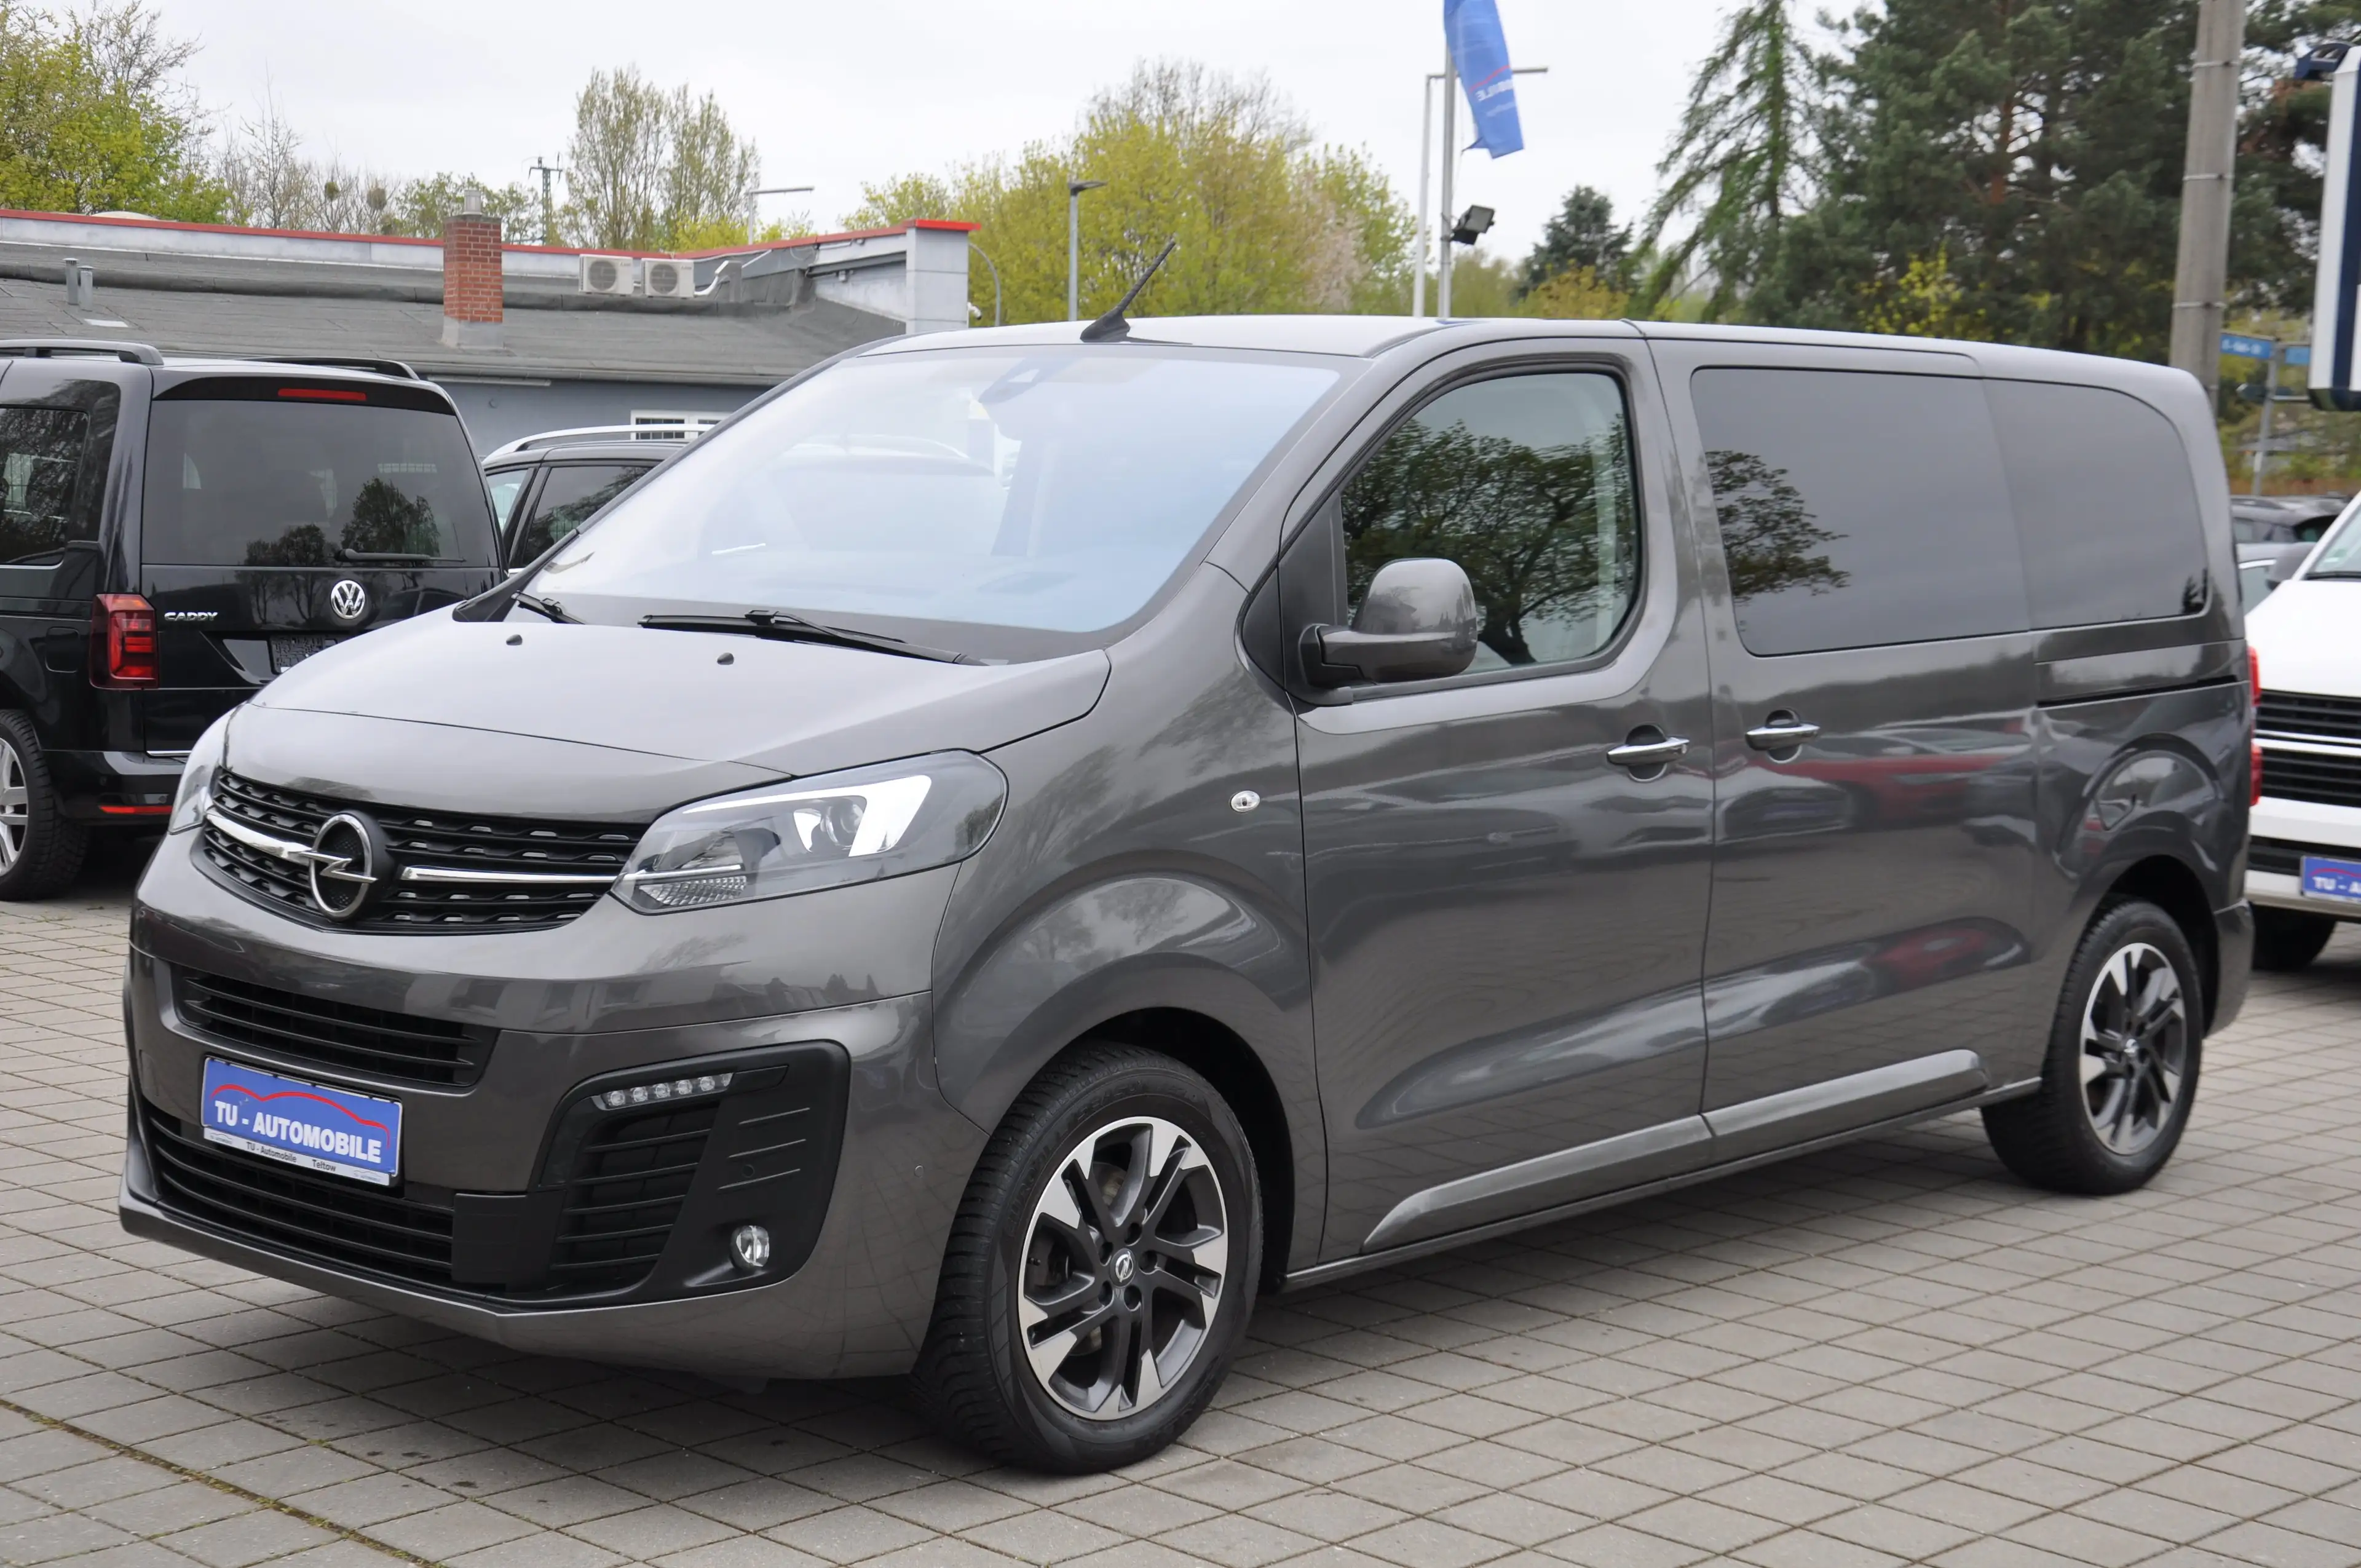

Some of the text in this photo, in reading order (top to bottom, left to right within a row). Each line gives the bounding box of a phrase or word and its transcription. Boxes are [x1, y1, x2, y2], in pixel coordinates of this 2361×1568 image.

[164, 612, 218, 621] CADDY
[2312, 876, 2336, 890] TU
[215, 1100, 238, 1127] TU
[253, 1112, 381, 1164] AUTOMOBILE
[247, 1141, 256, 1151] TU
[260, 1146, 297, 1163] Automobile
[312, 1159, 337, 1172] Teltow
